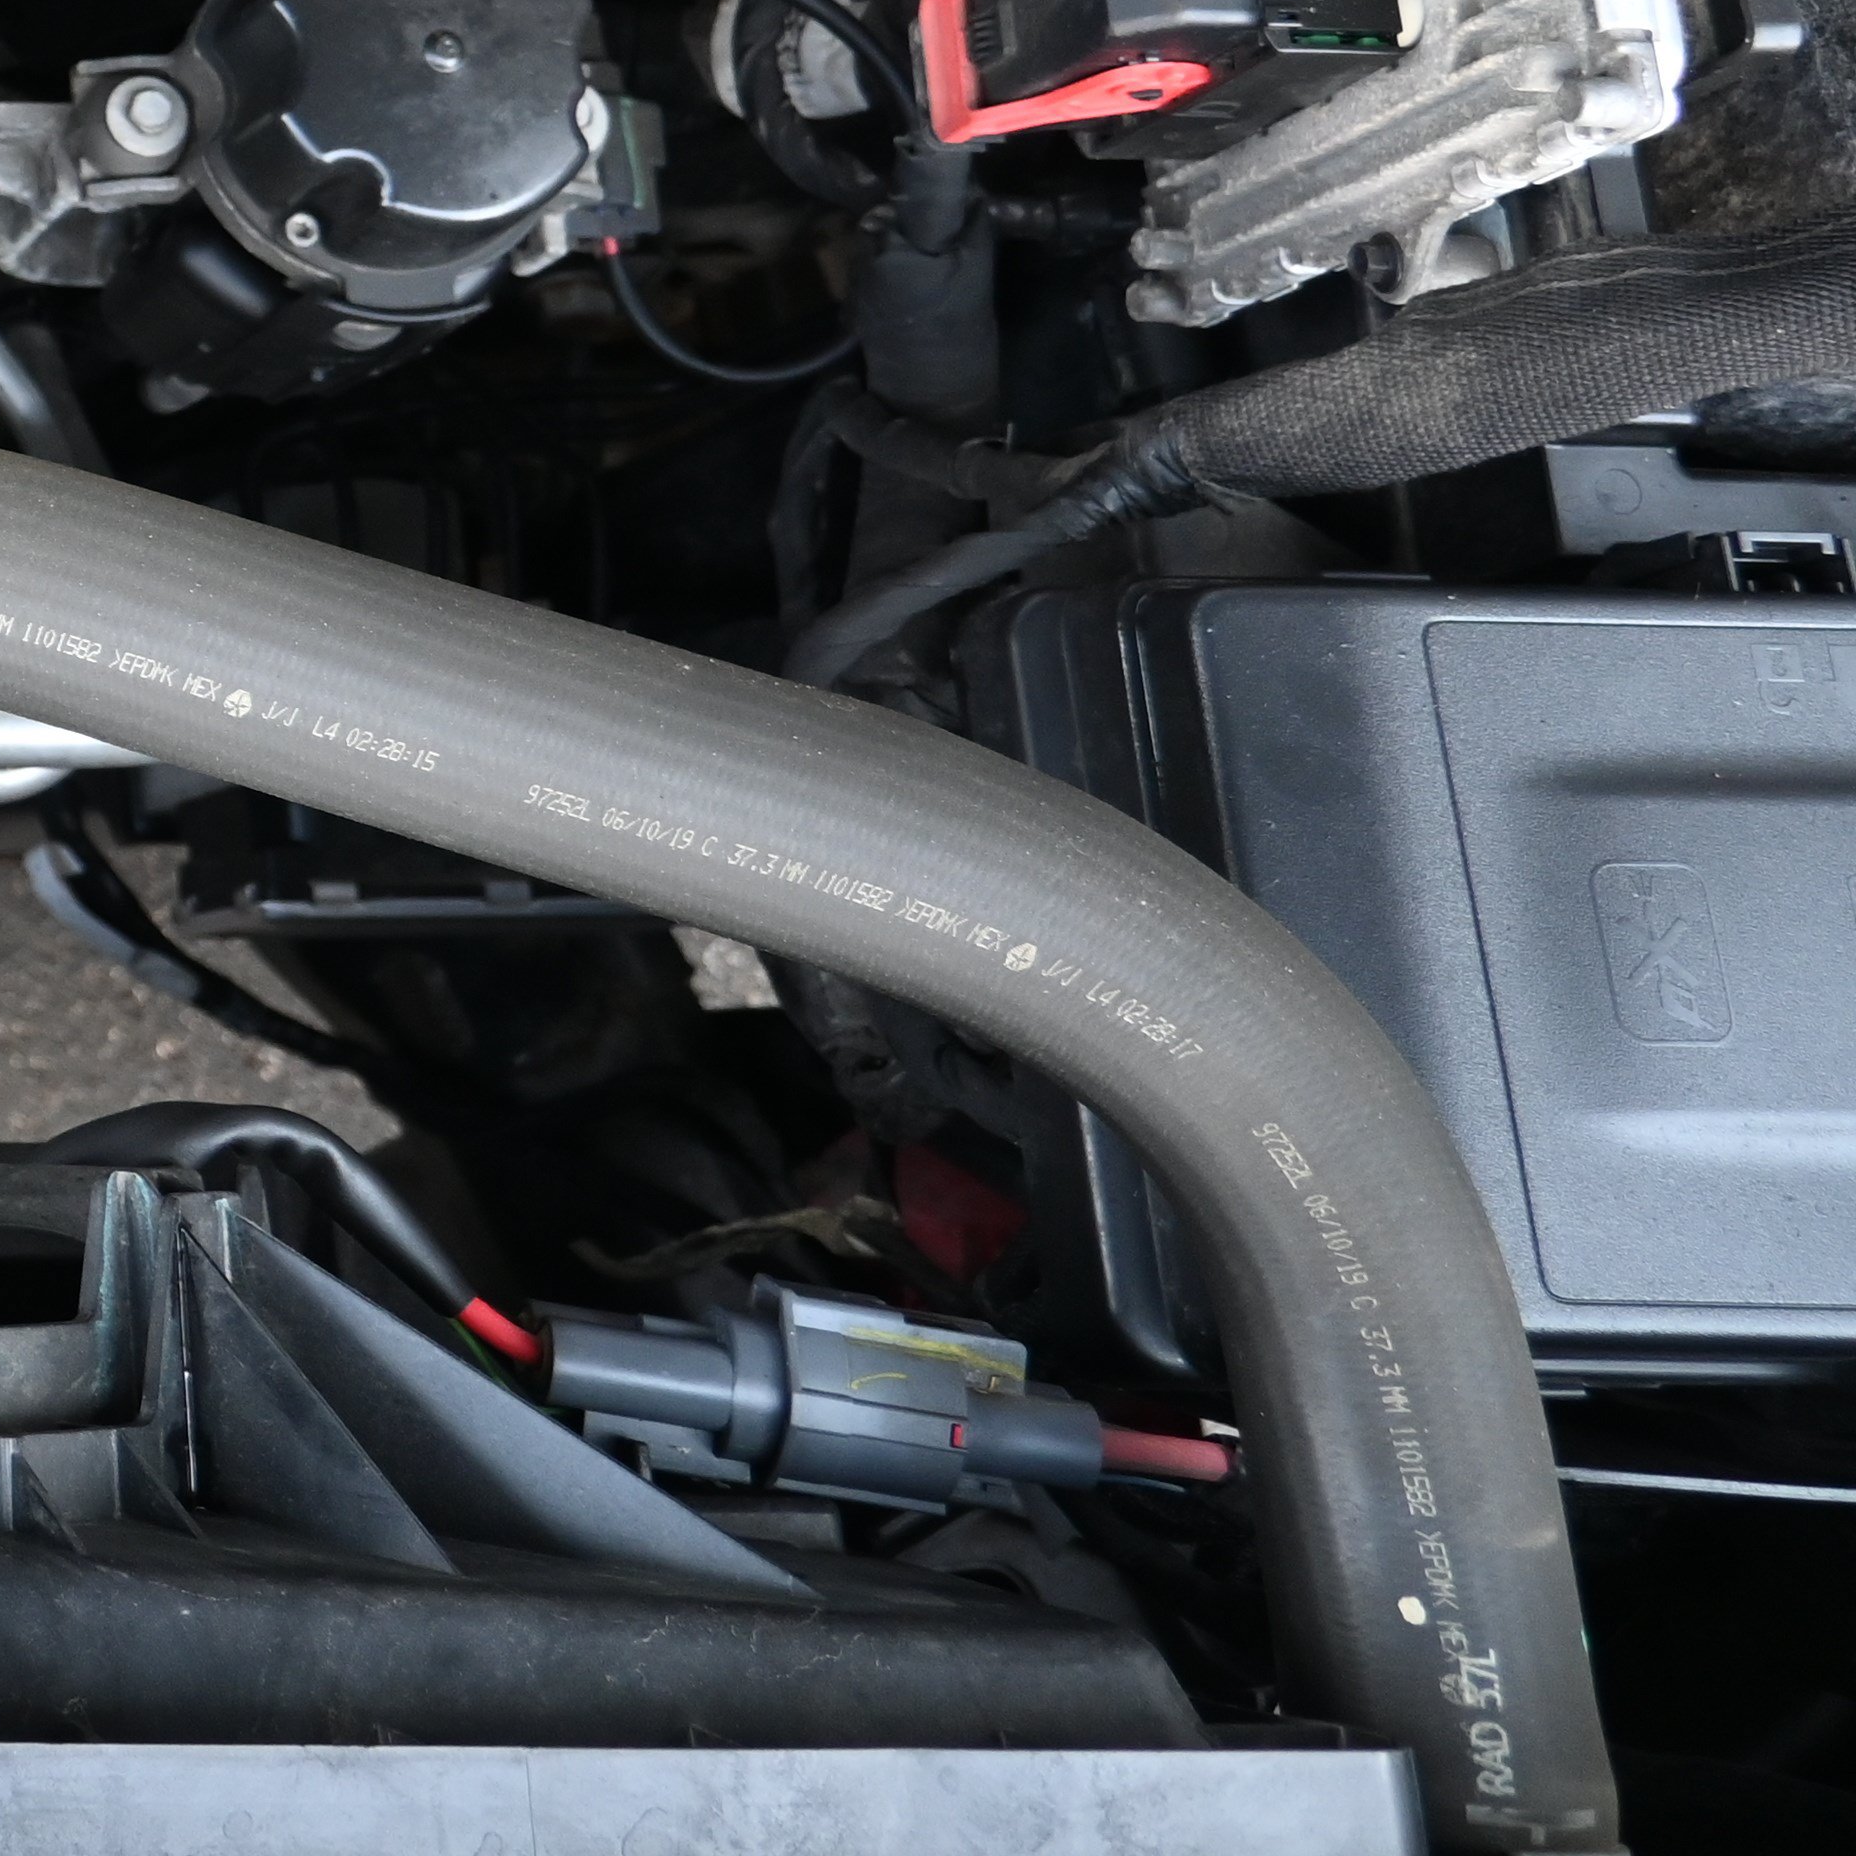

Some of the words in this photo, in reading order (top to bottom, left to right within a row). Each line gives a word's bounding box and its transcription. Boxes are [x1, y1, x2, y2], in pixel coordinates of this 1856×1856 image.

[21, 617, 103, 664] 1101582
[183, 673, 221, 701] MEX
[261, 699, 295, 729] J/J
[312, 713, 338, 742] L4
[346, 725, 439, 772] 02:28:15
[524, 784, 591, 821] 97252L
[601, 807, 694, 855] 06/10/19
[701, 837, 714, 857] C
[726, 843, 779, 877] 37.3
[779, 859, 805, 885] MM
[813, 870, 891, 913] 1101582
[967, 922, 1010, 953] MEX
[1041, 958, 1082, 987] J/J
[1087, 977, 1114, 1007] L4
[1114, 996, 1203, 1063] 02:28:17
[1252, 1121, 1311, 1189] 97252L
[1303, 1193, 1368, 1287] 06/10/19
[1352, 1296, 1377, 1310] C
[1365, 1325, 1401, 1377] 37.3
[1376, 1385, 1412, 1422] MM
[1387, 1425, 1436, 1519] 1101582
[1470, 1721, 1515, 1796] RAD
